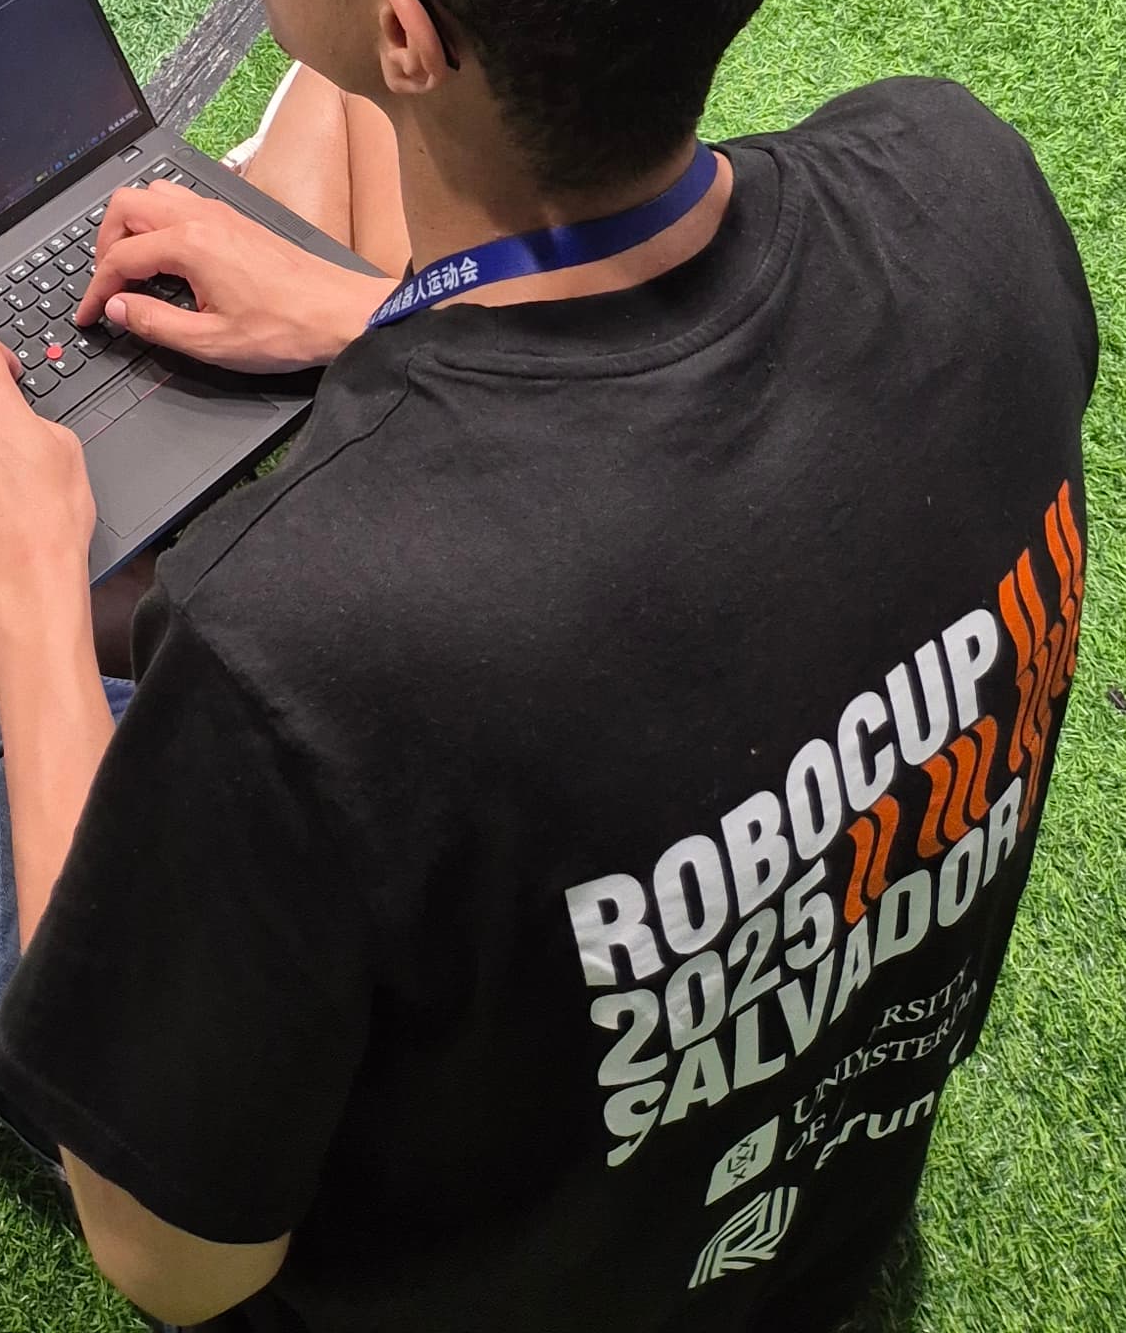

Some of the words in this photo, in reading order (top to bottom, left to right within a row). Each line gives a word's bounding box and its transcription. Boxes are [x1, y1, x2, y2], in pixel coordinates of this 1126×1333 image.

[565, 609, 999, 986] ROBOCUP
[590, 859, 835, 1086] 2025
[604, 777, 1023, 1167] SALVADOR
